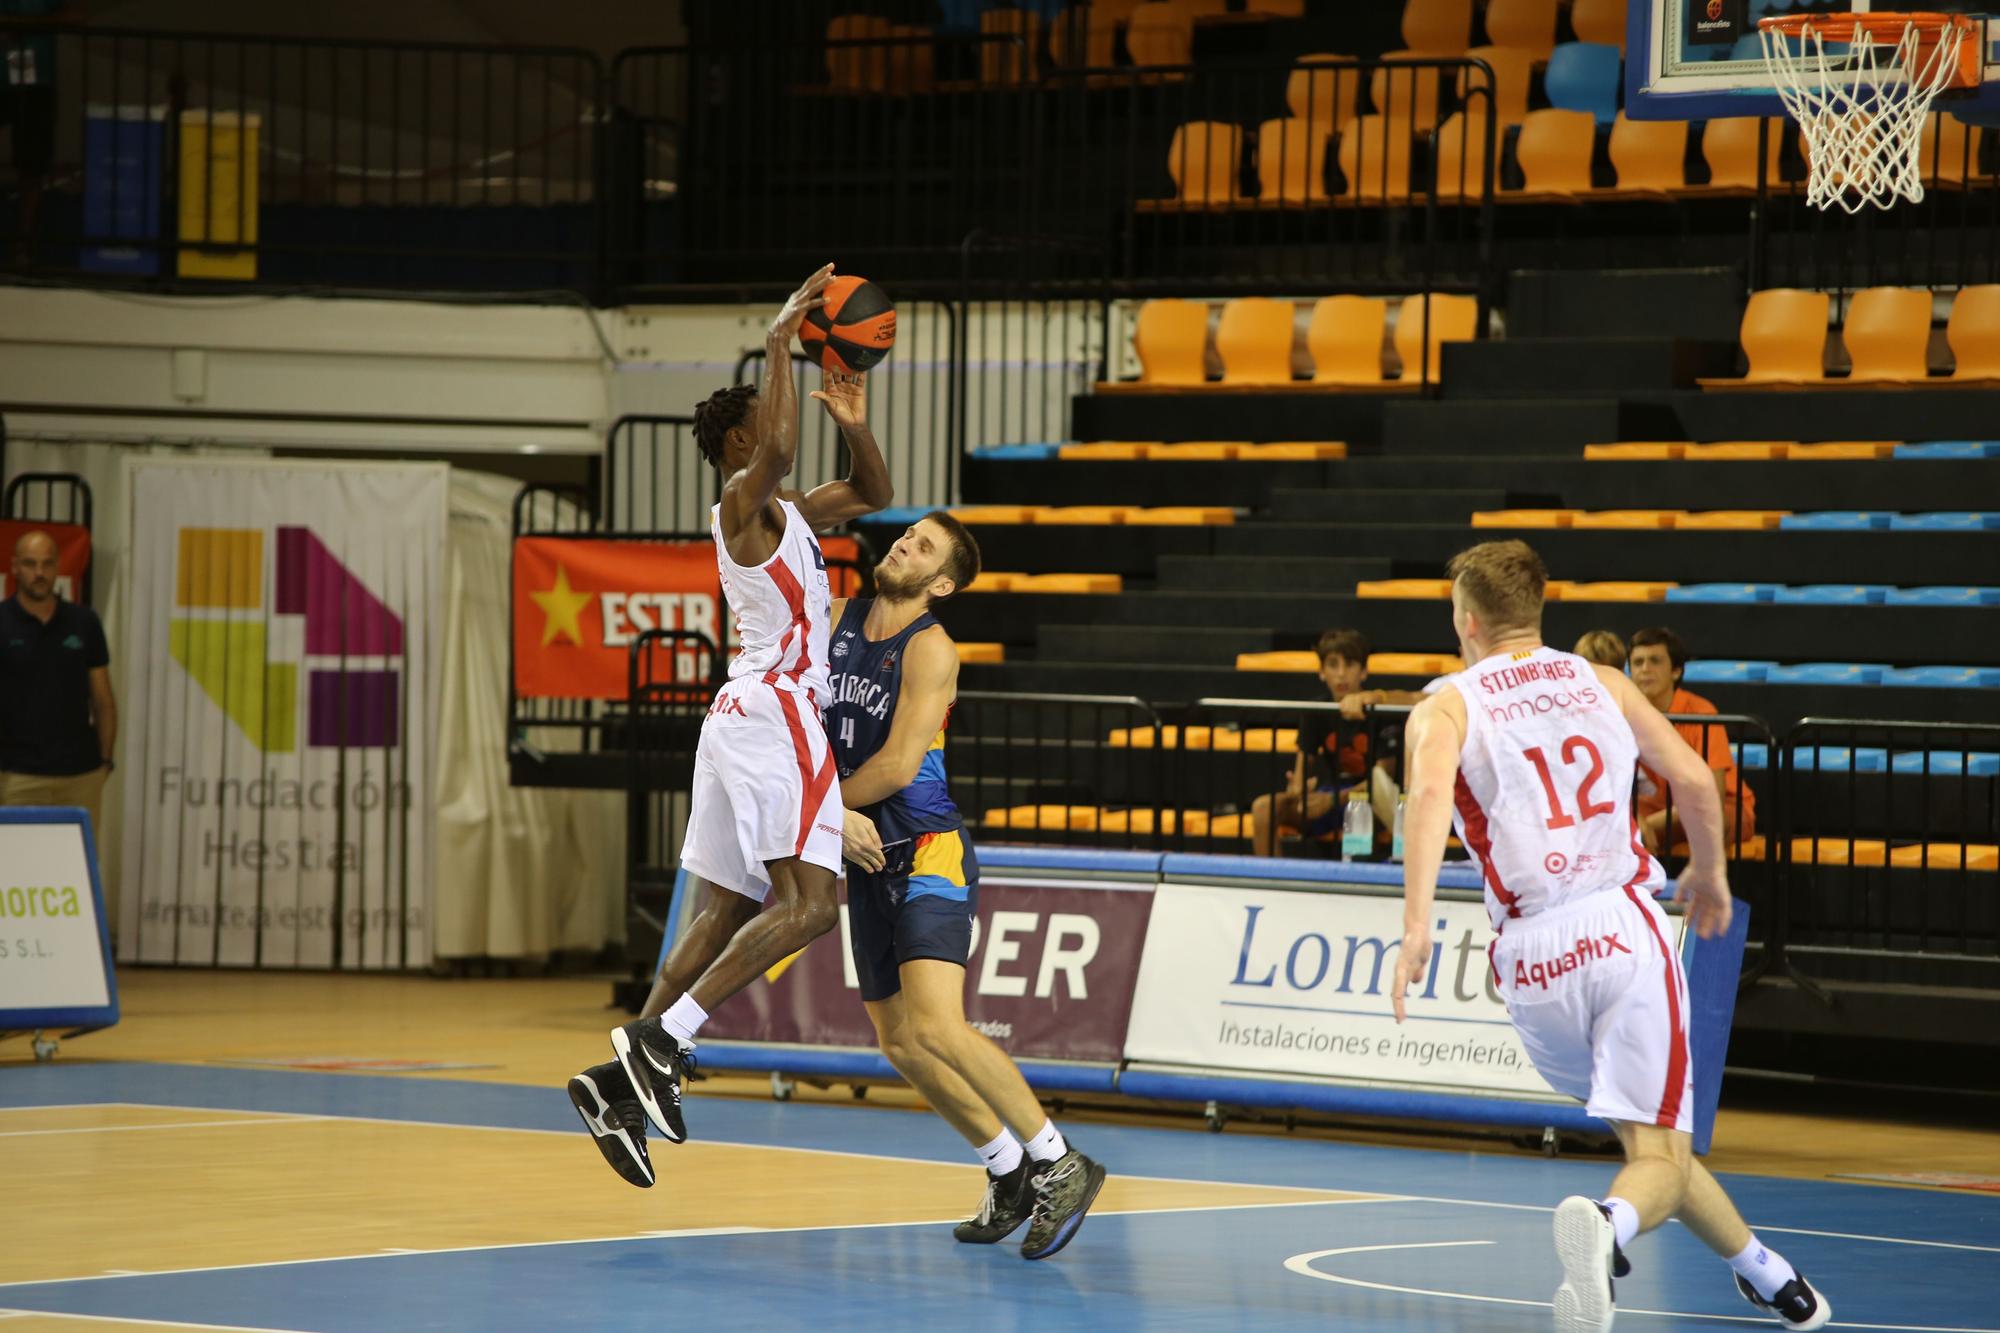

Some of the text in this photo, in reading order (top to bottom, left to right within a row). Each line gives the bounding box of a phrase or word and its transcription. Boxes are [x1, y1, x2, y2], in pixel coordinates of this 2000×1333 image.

[840, 717, 854, 748] 4
[1522, 734, 1616, 830] 12
[203, 830, 359, 872] Hestia
[1515, 933, 1632, 990] Aquaflix
[1218, 1020, 1522, 1070] Instalaciones e ingeniería,
